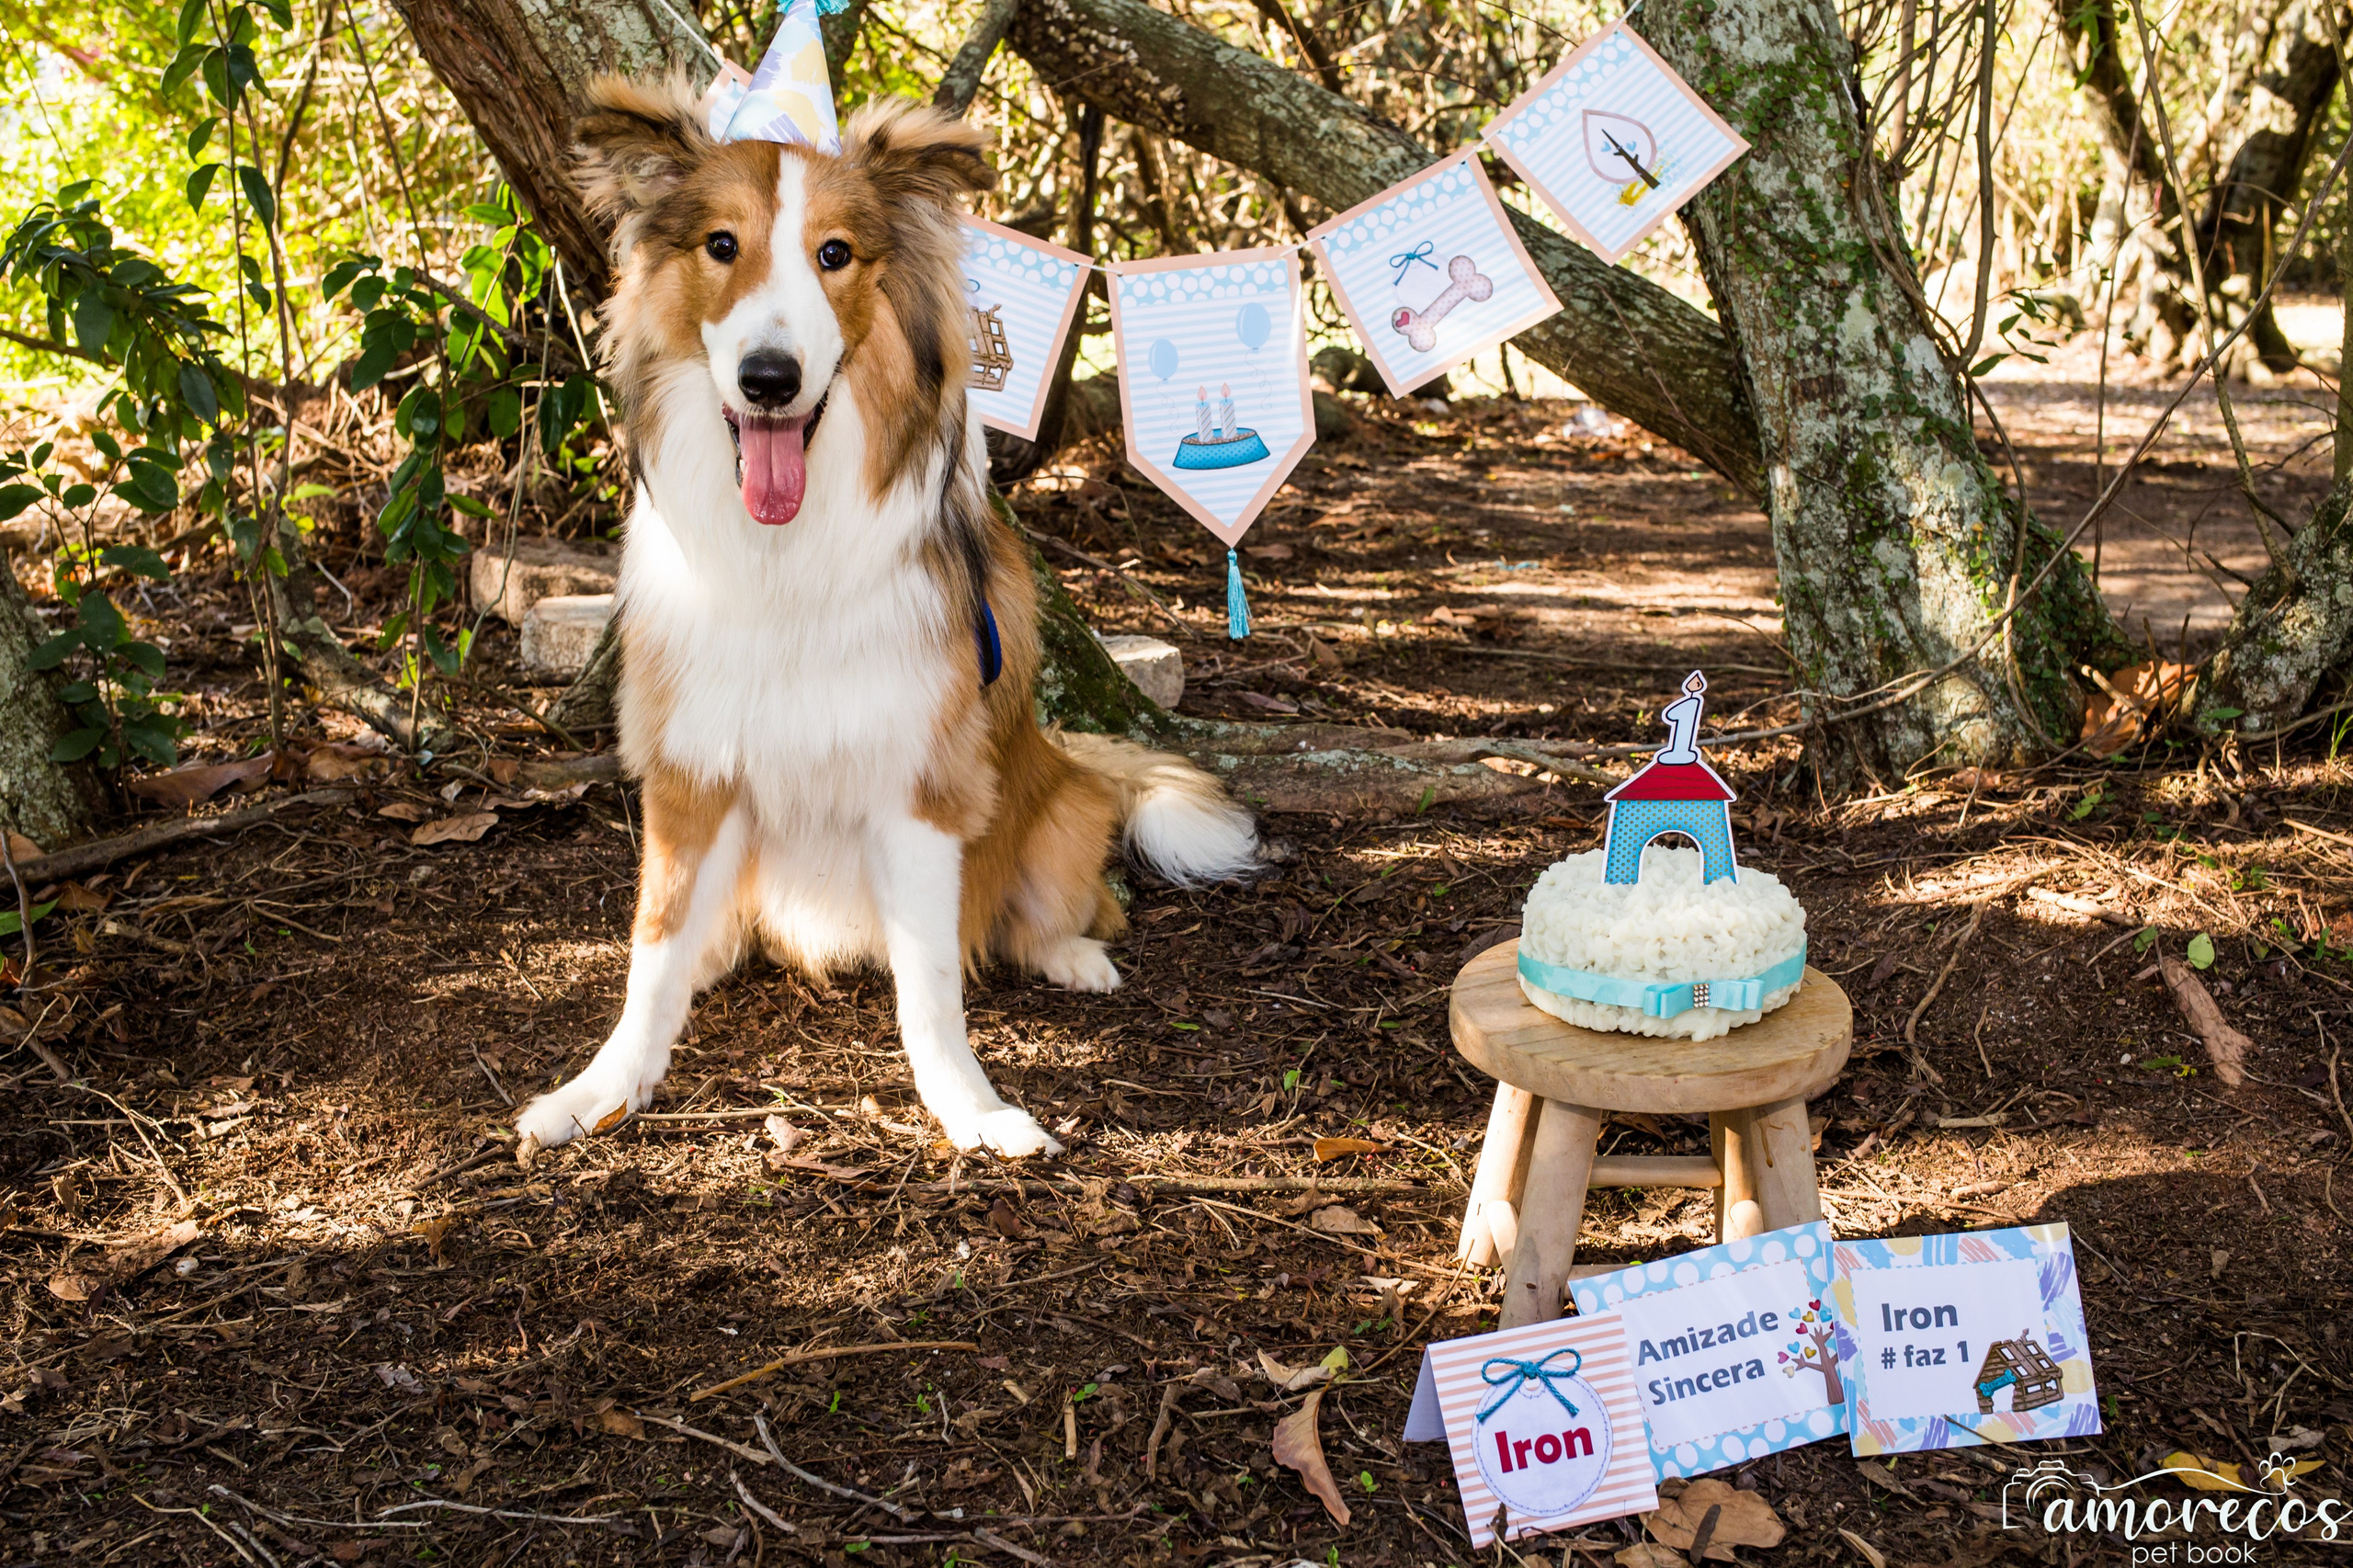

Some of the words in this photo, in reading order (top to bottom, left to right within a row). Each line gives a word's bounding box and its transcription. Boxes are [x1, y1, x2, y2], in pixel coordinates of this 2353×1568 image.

[1657, 697, 1700, 766] 1
[1638, 1311, 1779, 1366] Amizade
[1881, 1302, 1959, 1332] Iron
[1881, 1346, 1896, 1369] #
[1904, 1344, 1946, 1368] faz
[1957, 1341, 1969, 1363] 1
[1648, 1358, 1766, 1405] Sincera
[1495, 1427, 1594, 1473] Iron
